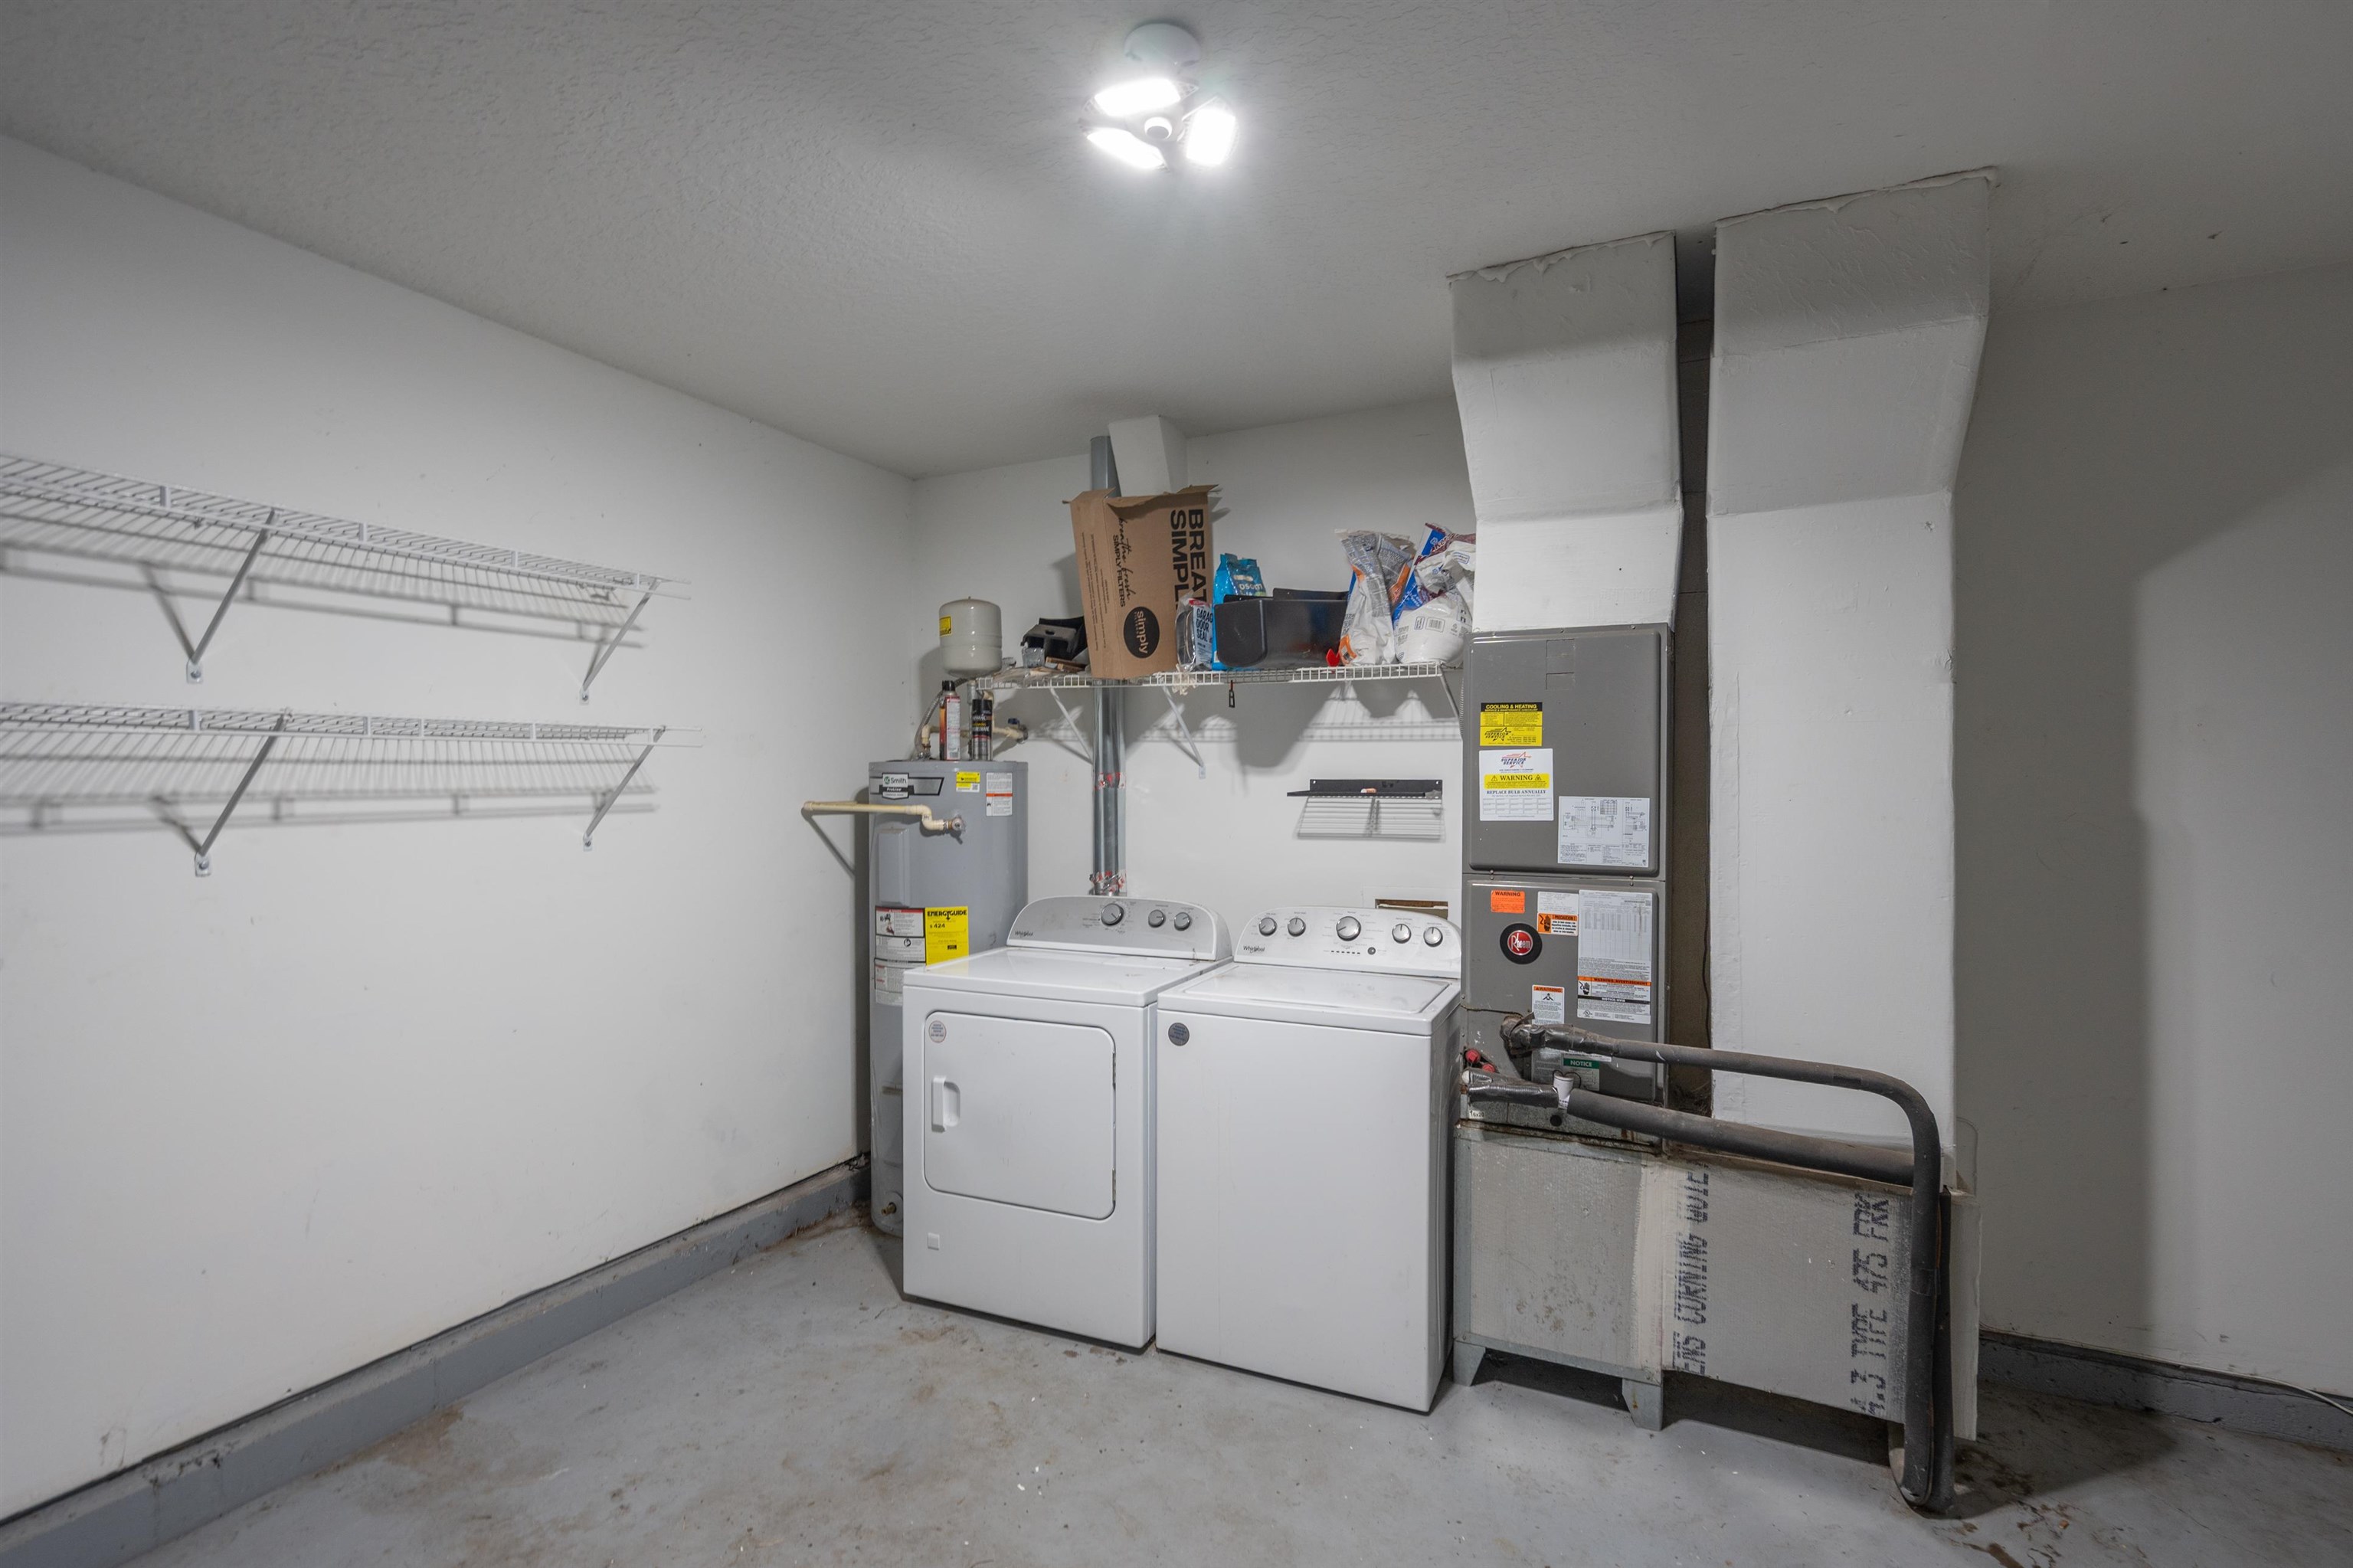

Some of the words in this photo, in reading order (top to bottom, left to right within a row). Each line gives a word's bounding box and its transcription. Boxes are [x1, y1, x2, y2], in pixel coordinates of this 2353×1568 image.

[1113, 535, 1122, 568] SIMPLY
[1170, 509, 1190, 611] SIMPL
[1117, 570, 1126, 607] FILTERS
[1135, 611, 1149, 654] simply
[1196, 618, 1209, 632] DOOR
[1196, 629, 1208, 642] SEAL
[890, 776, 907, 784] Smith
[1242, 945, 1265, 954] Whirlpool
[1510, 931, 1531, 952] Rheem
[1676, 1160, 1710, 1224] QUIE
[1673, 1232, 1708, 1324] CORNING
[1851, 1303, 1887, 1360] TYPE
